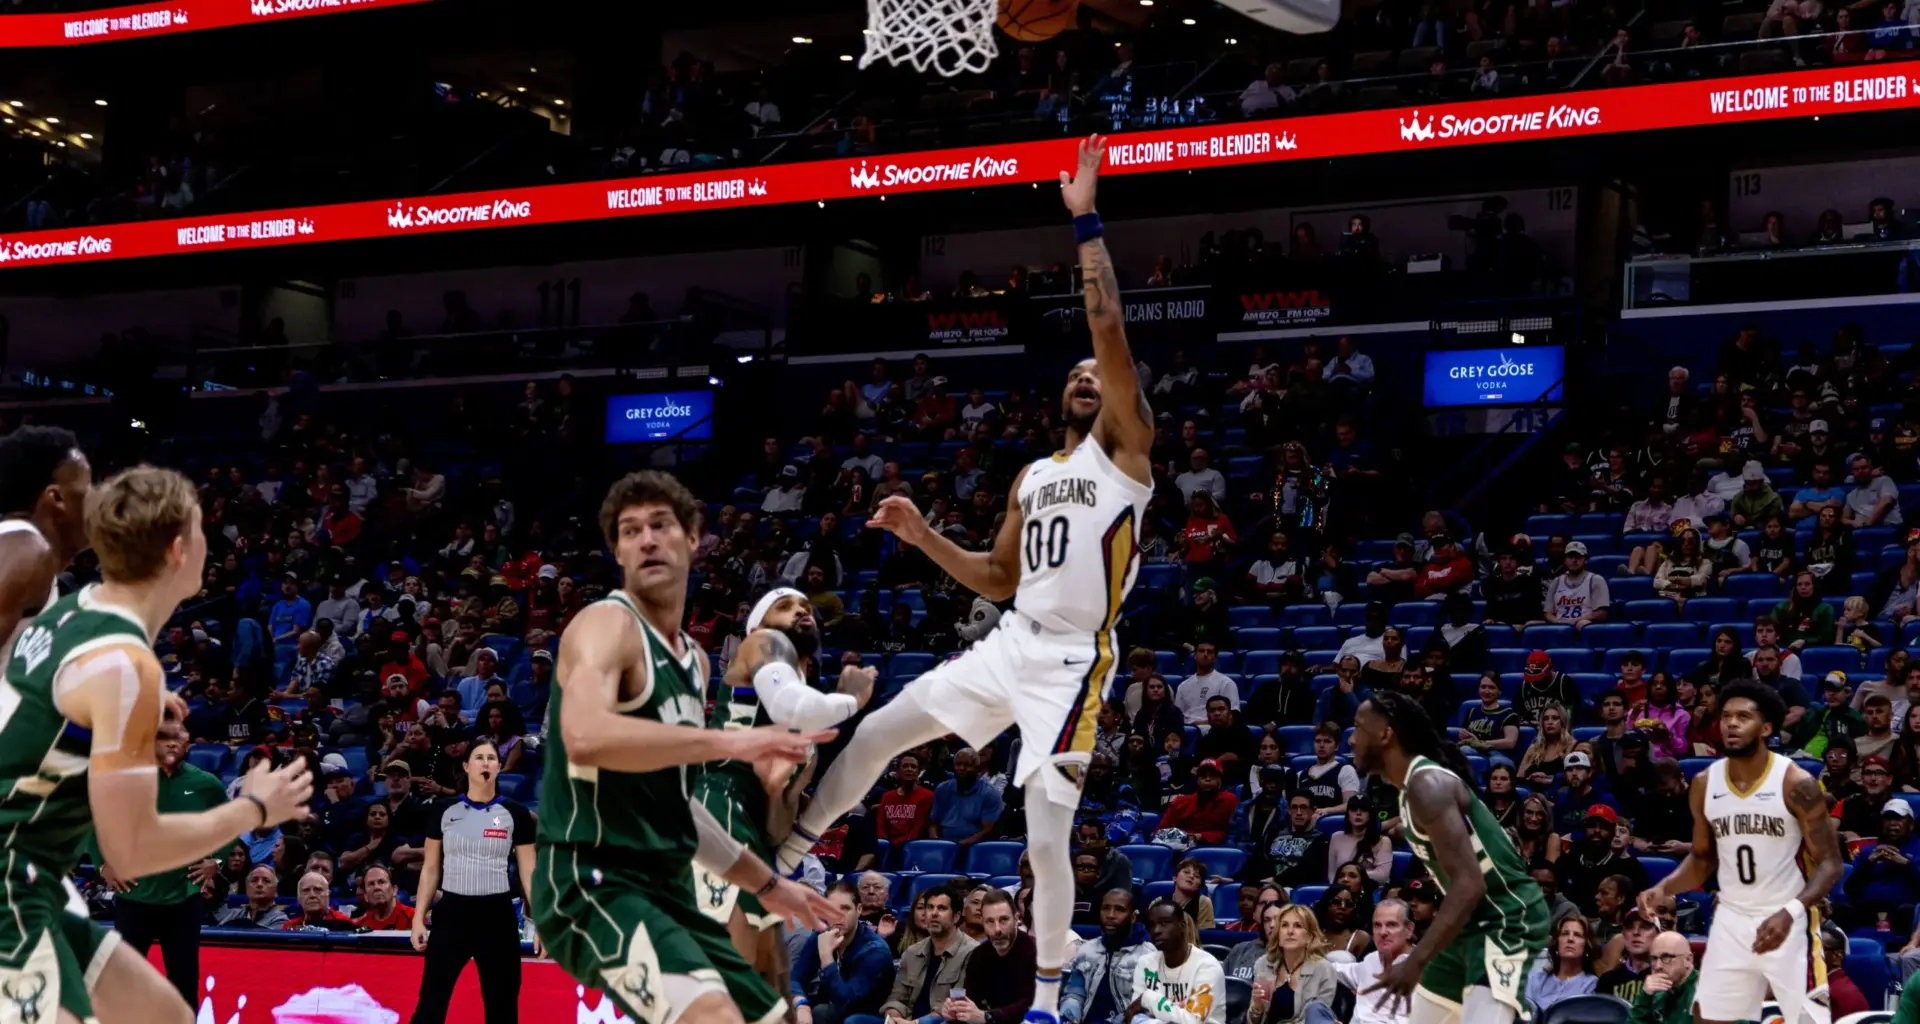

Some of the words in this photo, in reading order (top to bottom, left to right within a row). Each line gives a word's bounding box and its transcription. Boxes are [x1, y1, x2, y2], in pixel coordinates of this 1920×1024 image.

[64, 18, 108, 38] WELCOME
[110, 19, 118, 31] TO
[119, 17, 131, 30] THE
[132, 10, 171, 31] BLENDER
[1710, 86, 1788, 114] WELCOME
[1793, 88, 1806, 103] TO
[1809, 85, 1830, 102] THE
[1833, 75, 1906, 103] BLENDER
[1438, 112, 1544, 138] SMOOTHIE
[1108, 141, 1174, 167] WELCOME
[1176, 142, 1188, 158] TO
[1190, 141, 1208, 157] THE
[1210, 132, 1270, 158] BLENDER
[882, 162, 971, 187] SMOOTHIE
[1735, 173, 1761, 197] 113
[607, 186, 662, 209] WELCOME
[665, 188, 675, 202] TO
[677, 186, 692, 200] THE
[694, 179, 745, 202] BLENDER
[1547, 188, 1572, 211] 112
[415, 205, 491, 226] SMOOTHIE
[177, 224, 225, 246] WELCOME
[227, 226, 237, 239] TO
[237, 224, 250, 238] THE
[251, 218, 295, 240] BLENDER
[12, 241, 78, 260] SMOOTHIE
[537, 278, 580, 328] 111
[1167, 299, 1205, 320] RADIO
[1240, 289, 1331, 311] WWL
[1450, 366, 1484, 379] GREY
[1487, 363, 1534, 377] GOOSE
[1476, 382, 1507, 390] VODKA
[626, 408, 653, 420] GREY
[654, 405, 691, 418] GOOSE
[646, 421, 670, 429] VODKA
[1037, 478, 1097, 510] ORLEANS
[1025, 515, 1070, 573] 00
[885, 804, 917, 819] NANI
[1734, 814, 1785, 837] ORLEANS
[1736, 844, 1756, 885] 0
